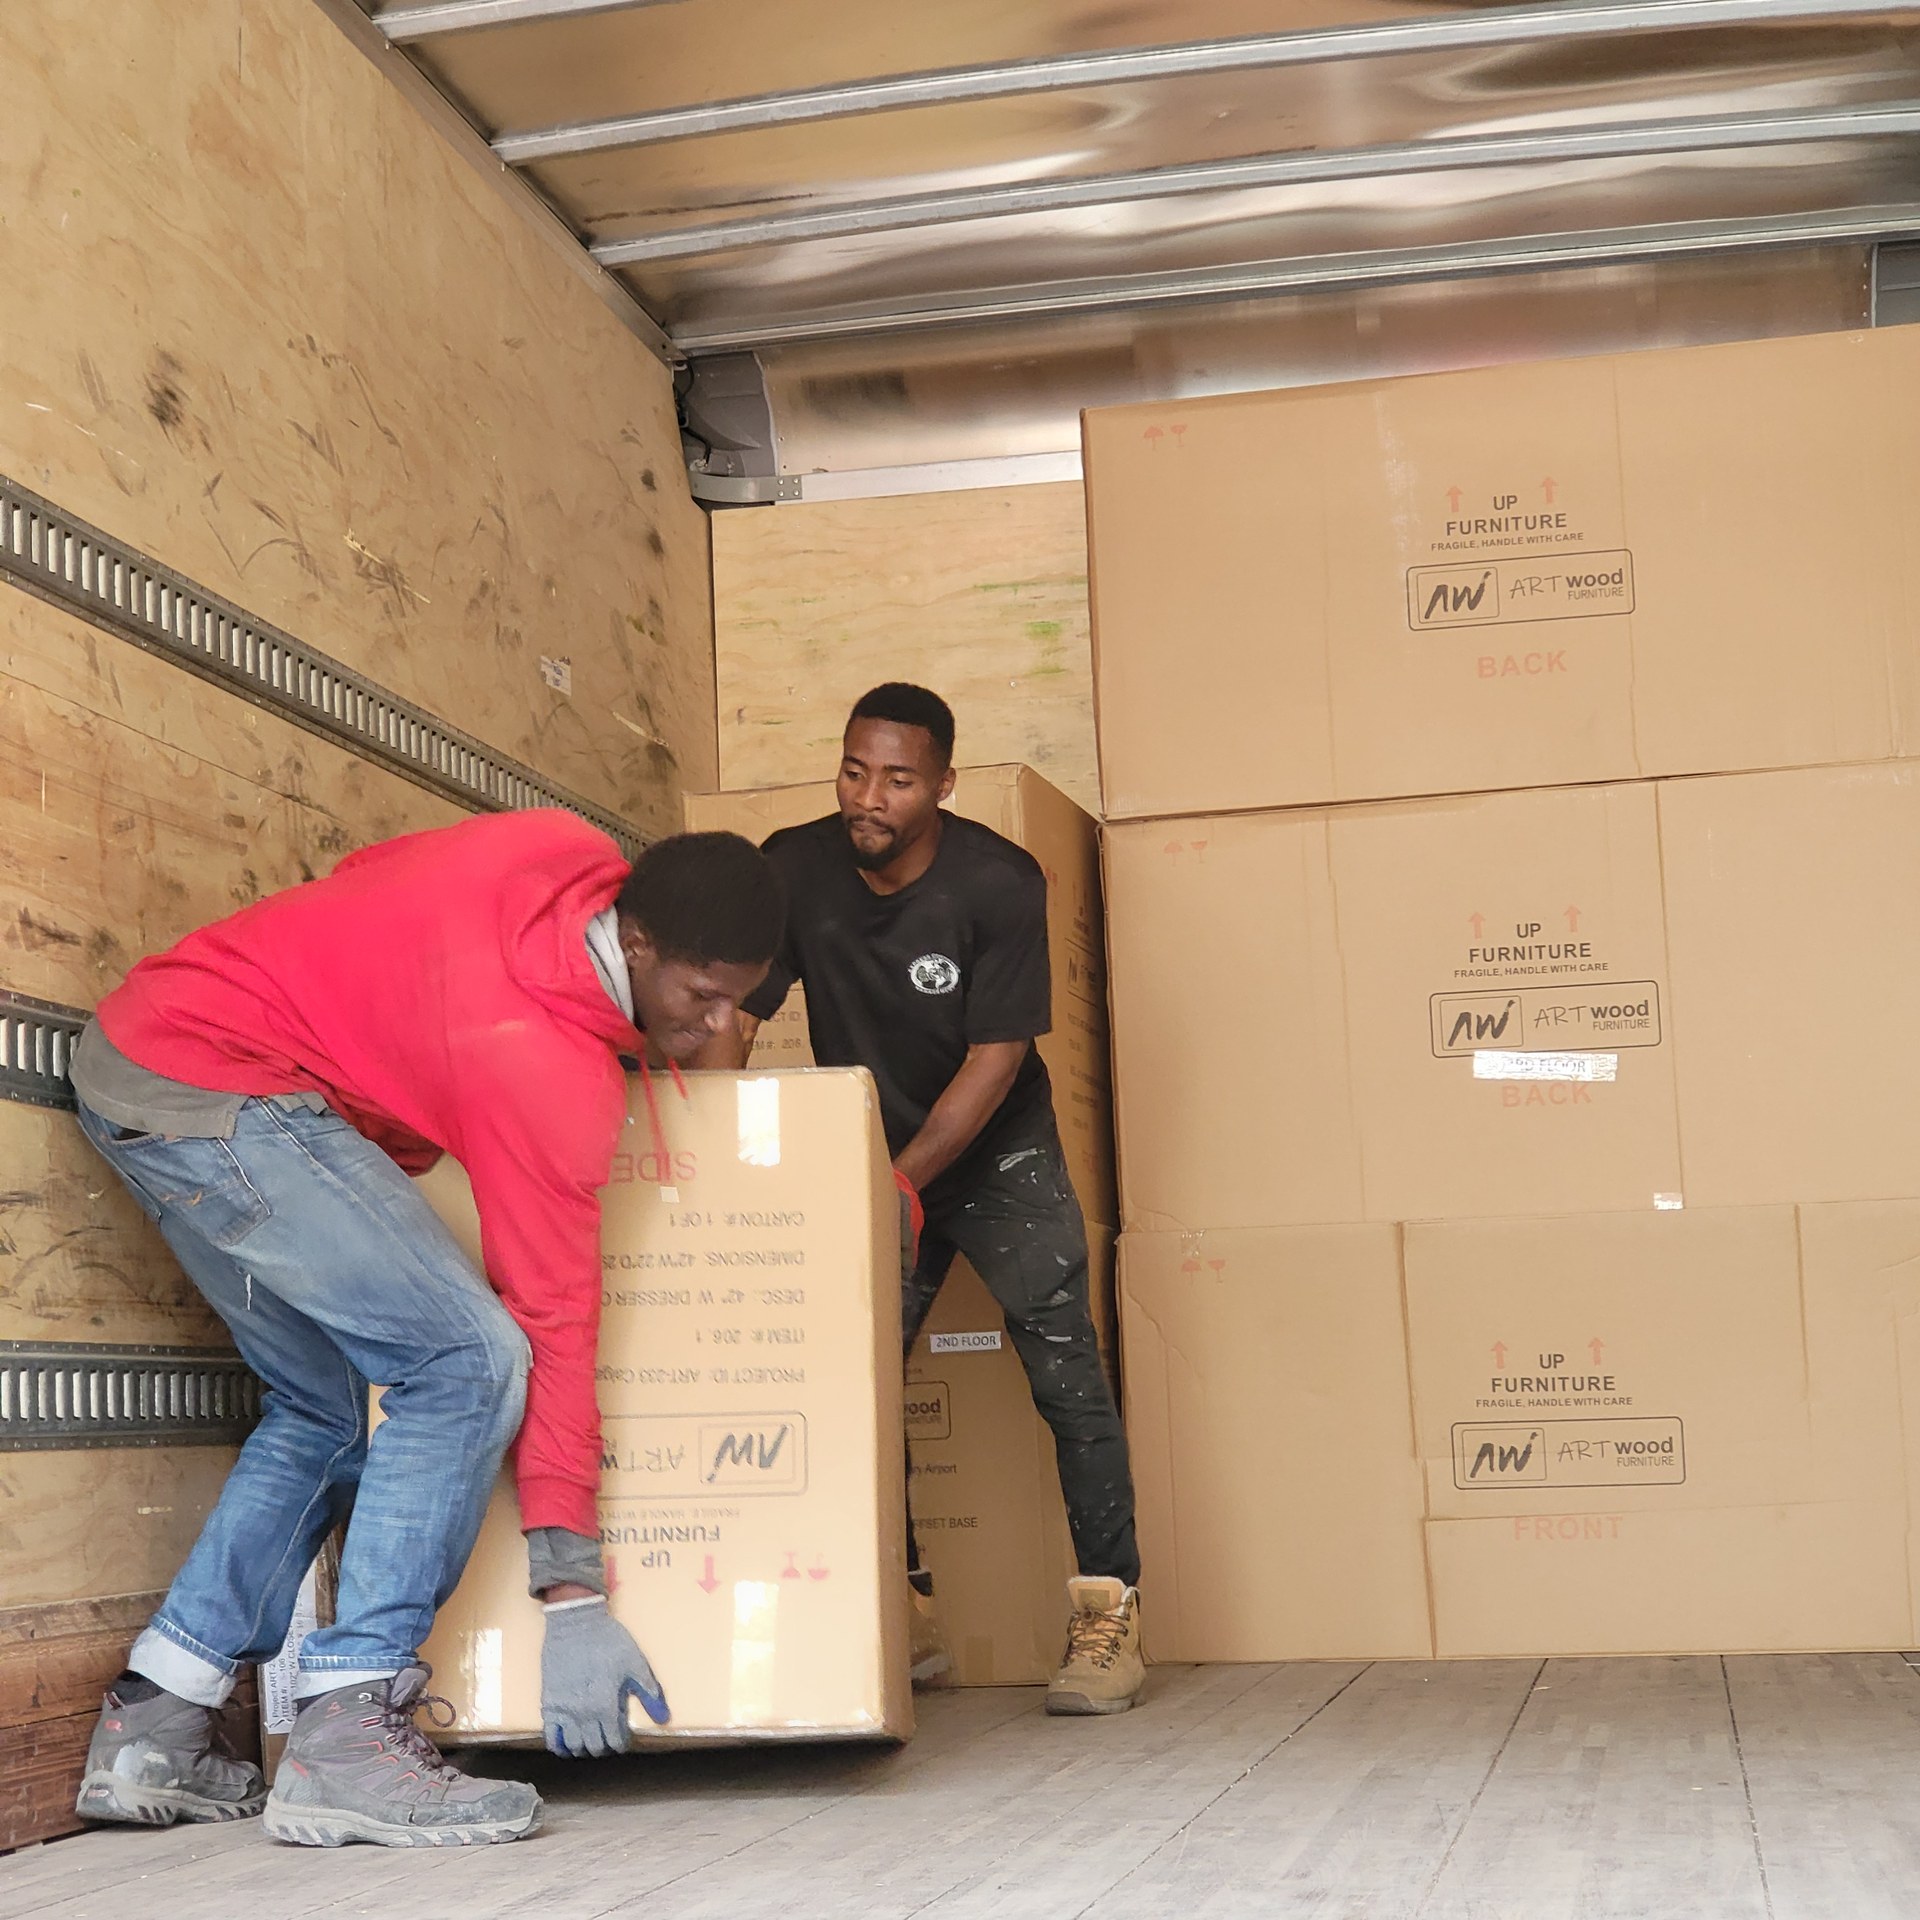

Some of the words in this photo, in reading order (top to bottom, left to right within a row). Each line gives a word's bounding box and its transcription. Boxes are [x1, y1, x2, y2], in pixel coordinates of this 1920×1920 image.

[1493, 495, 1518, 510] UP
[1446, 513, 1568, 536] FURNITURE
[1431, 540, 1479, 551] FRAGILE,
[1481, 536, 1524, 548] HANDLE
[1527, 534, 1553, 544] WITH
[1555, 532, 1585, 542] CARE
[1567, 586, 1625, 600] FURNITURE
[1477, 650, 1568, 679] BACK
[1516, 923, 1542, 939] UP
[1469, 942, 1592, 963] FURNITURE
[1454, 968, 1503, 978] FRAGILE,
[1505, 966, 1548, 975] HANDLE
[1550, 964, 1577, 974] WITH
[1579, 963, 1609, 972] CARE
[1593, 1018, 1650, 1031] FURNITURE
[1502, 1083, 1592, 1108] BACK
[612, 1151, 697, 1184] SIDE
[670, 1212, 676, 1228] 1
[679, 1211, 702, 1228] OF
[707, 1211, 713, 1227] 1
[740, 1211, 805, 1227] CARTON
[615, 1290, 690, 1306] DRESSER
[698, 1289, 715, 1305] W
[767, 1328, 805, 1344] ITEM
[936, 1337, 958, 1348] 2ND
[961, 1334, 997, 1347] FLOOR
[1539, 1353, 1565, 1369] UP
[731, 1367, 805, 1384] PROJECT
[1491, 1376, 1616, 1393] FURNITURE
[1475, 1399, 1526, 1408] FRAGILE,
[1528, 1398, 1572, 1407] HANDLE
[1574, 1397, 1601, 1406] WITH
[1603, 1396, 1633, 1406] CARE
[925, 1464, 957, 1475] Airport
[1617, 1456, 1675, 1467] FURNITURE
[949, 1517, 979, 1529] BASE
[1514, 1516, 1624, 1541] FRONT
[641, 1549, 671, 1569] UP
[271, 1690, 280, 1718] Project
[281, 1696, 289, 1718] ITEM
